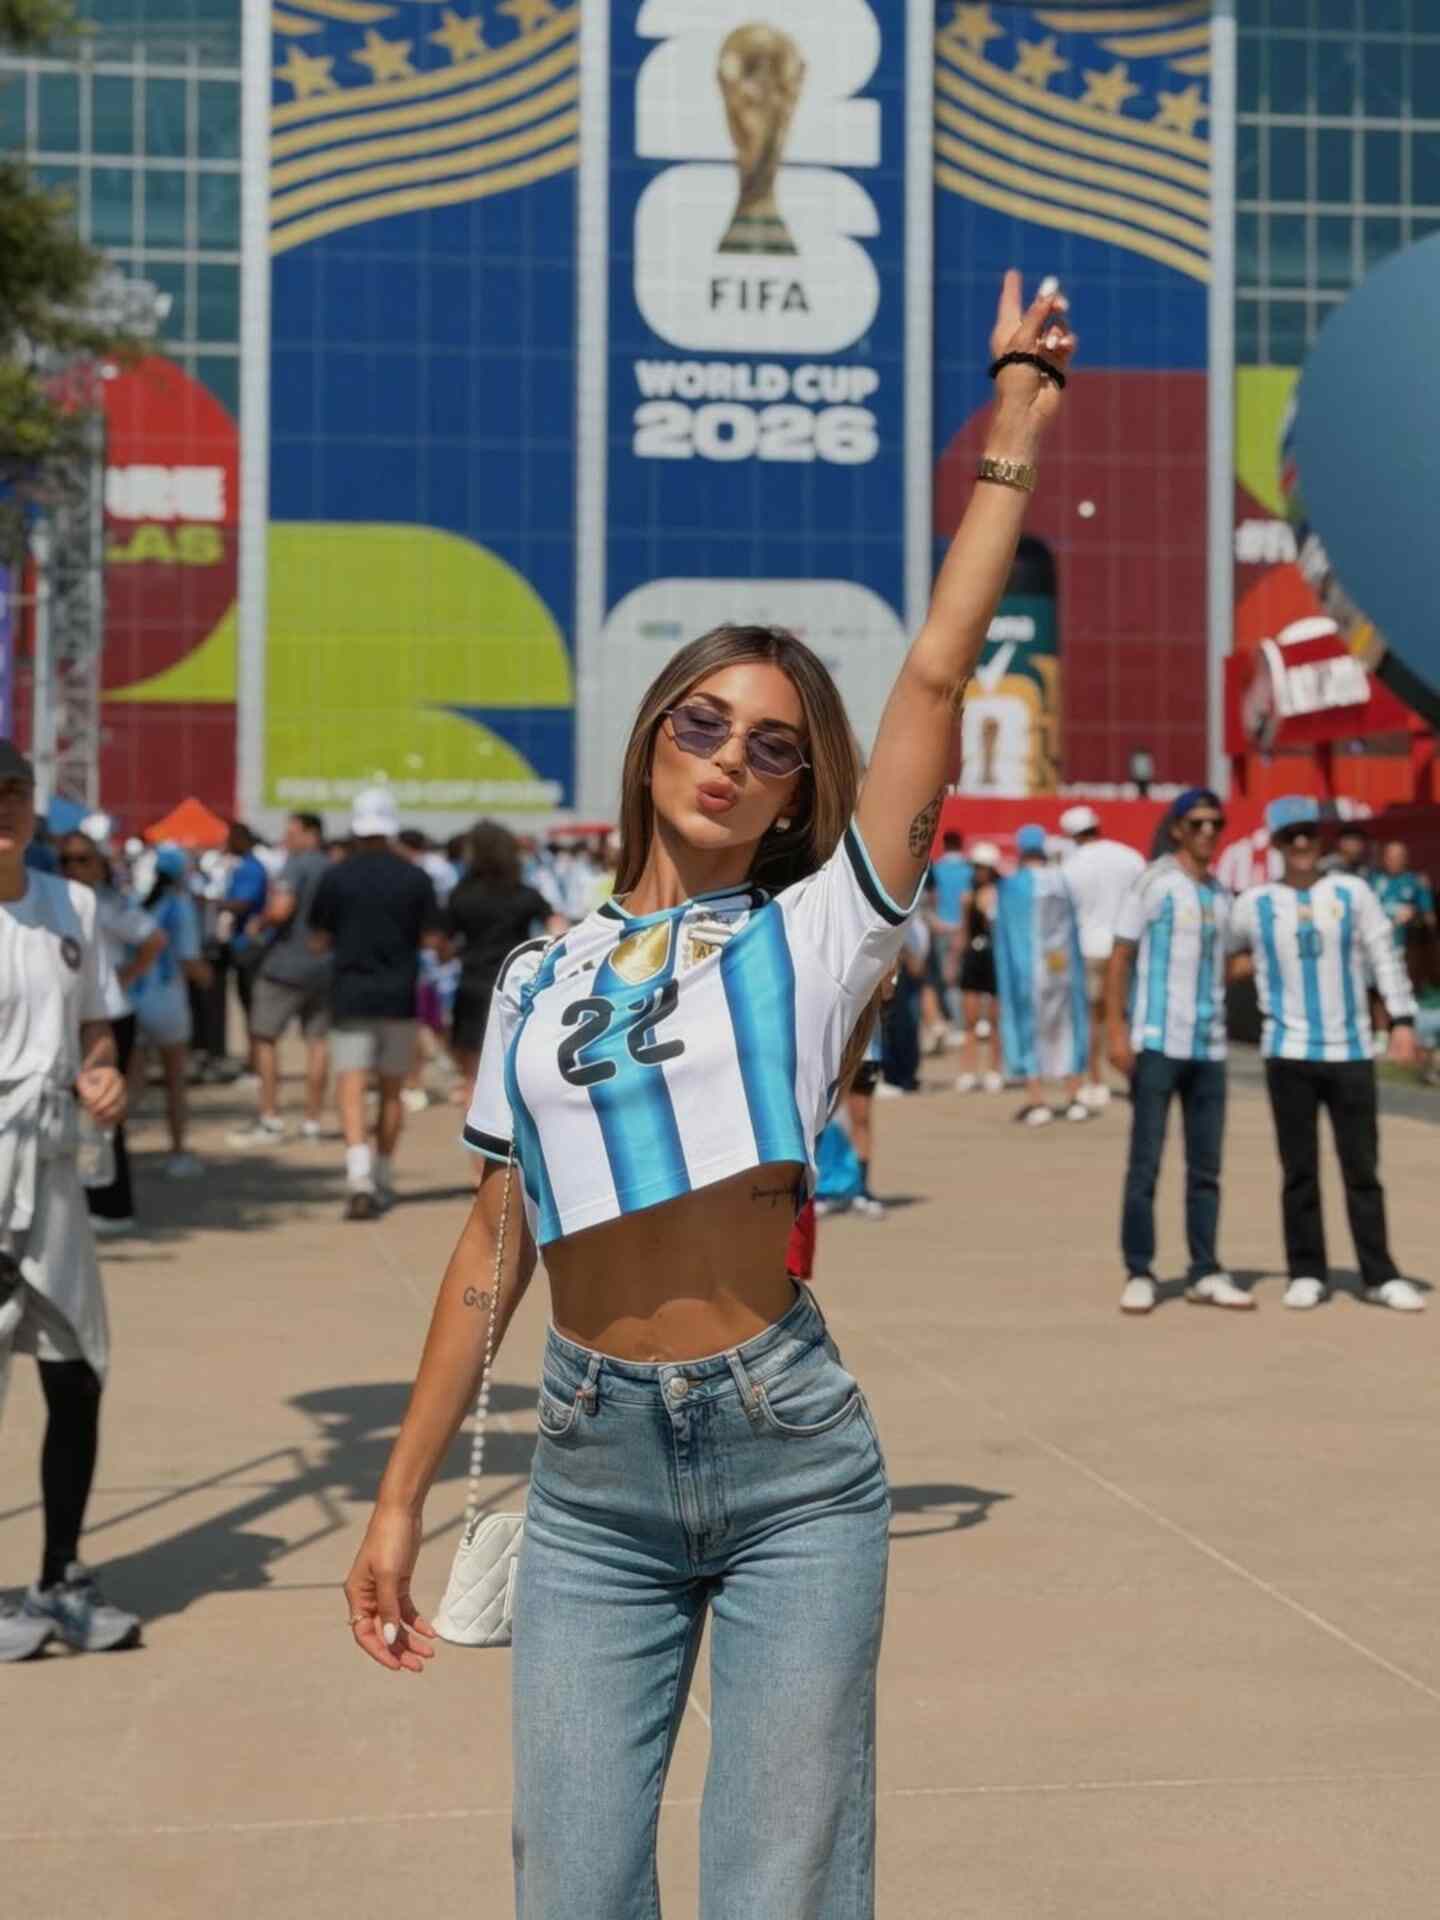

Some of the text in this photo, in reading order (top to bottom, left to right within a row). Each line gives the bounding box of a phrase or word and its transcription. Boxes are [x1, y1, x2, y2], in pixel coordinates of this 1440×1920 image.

[710, 277, 810, 314] FIFA
[634, 360, 879, 402] WORLD CUP
[633, 401, 880, 465] 2026
[557, 977, 686, 1088] 22
